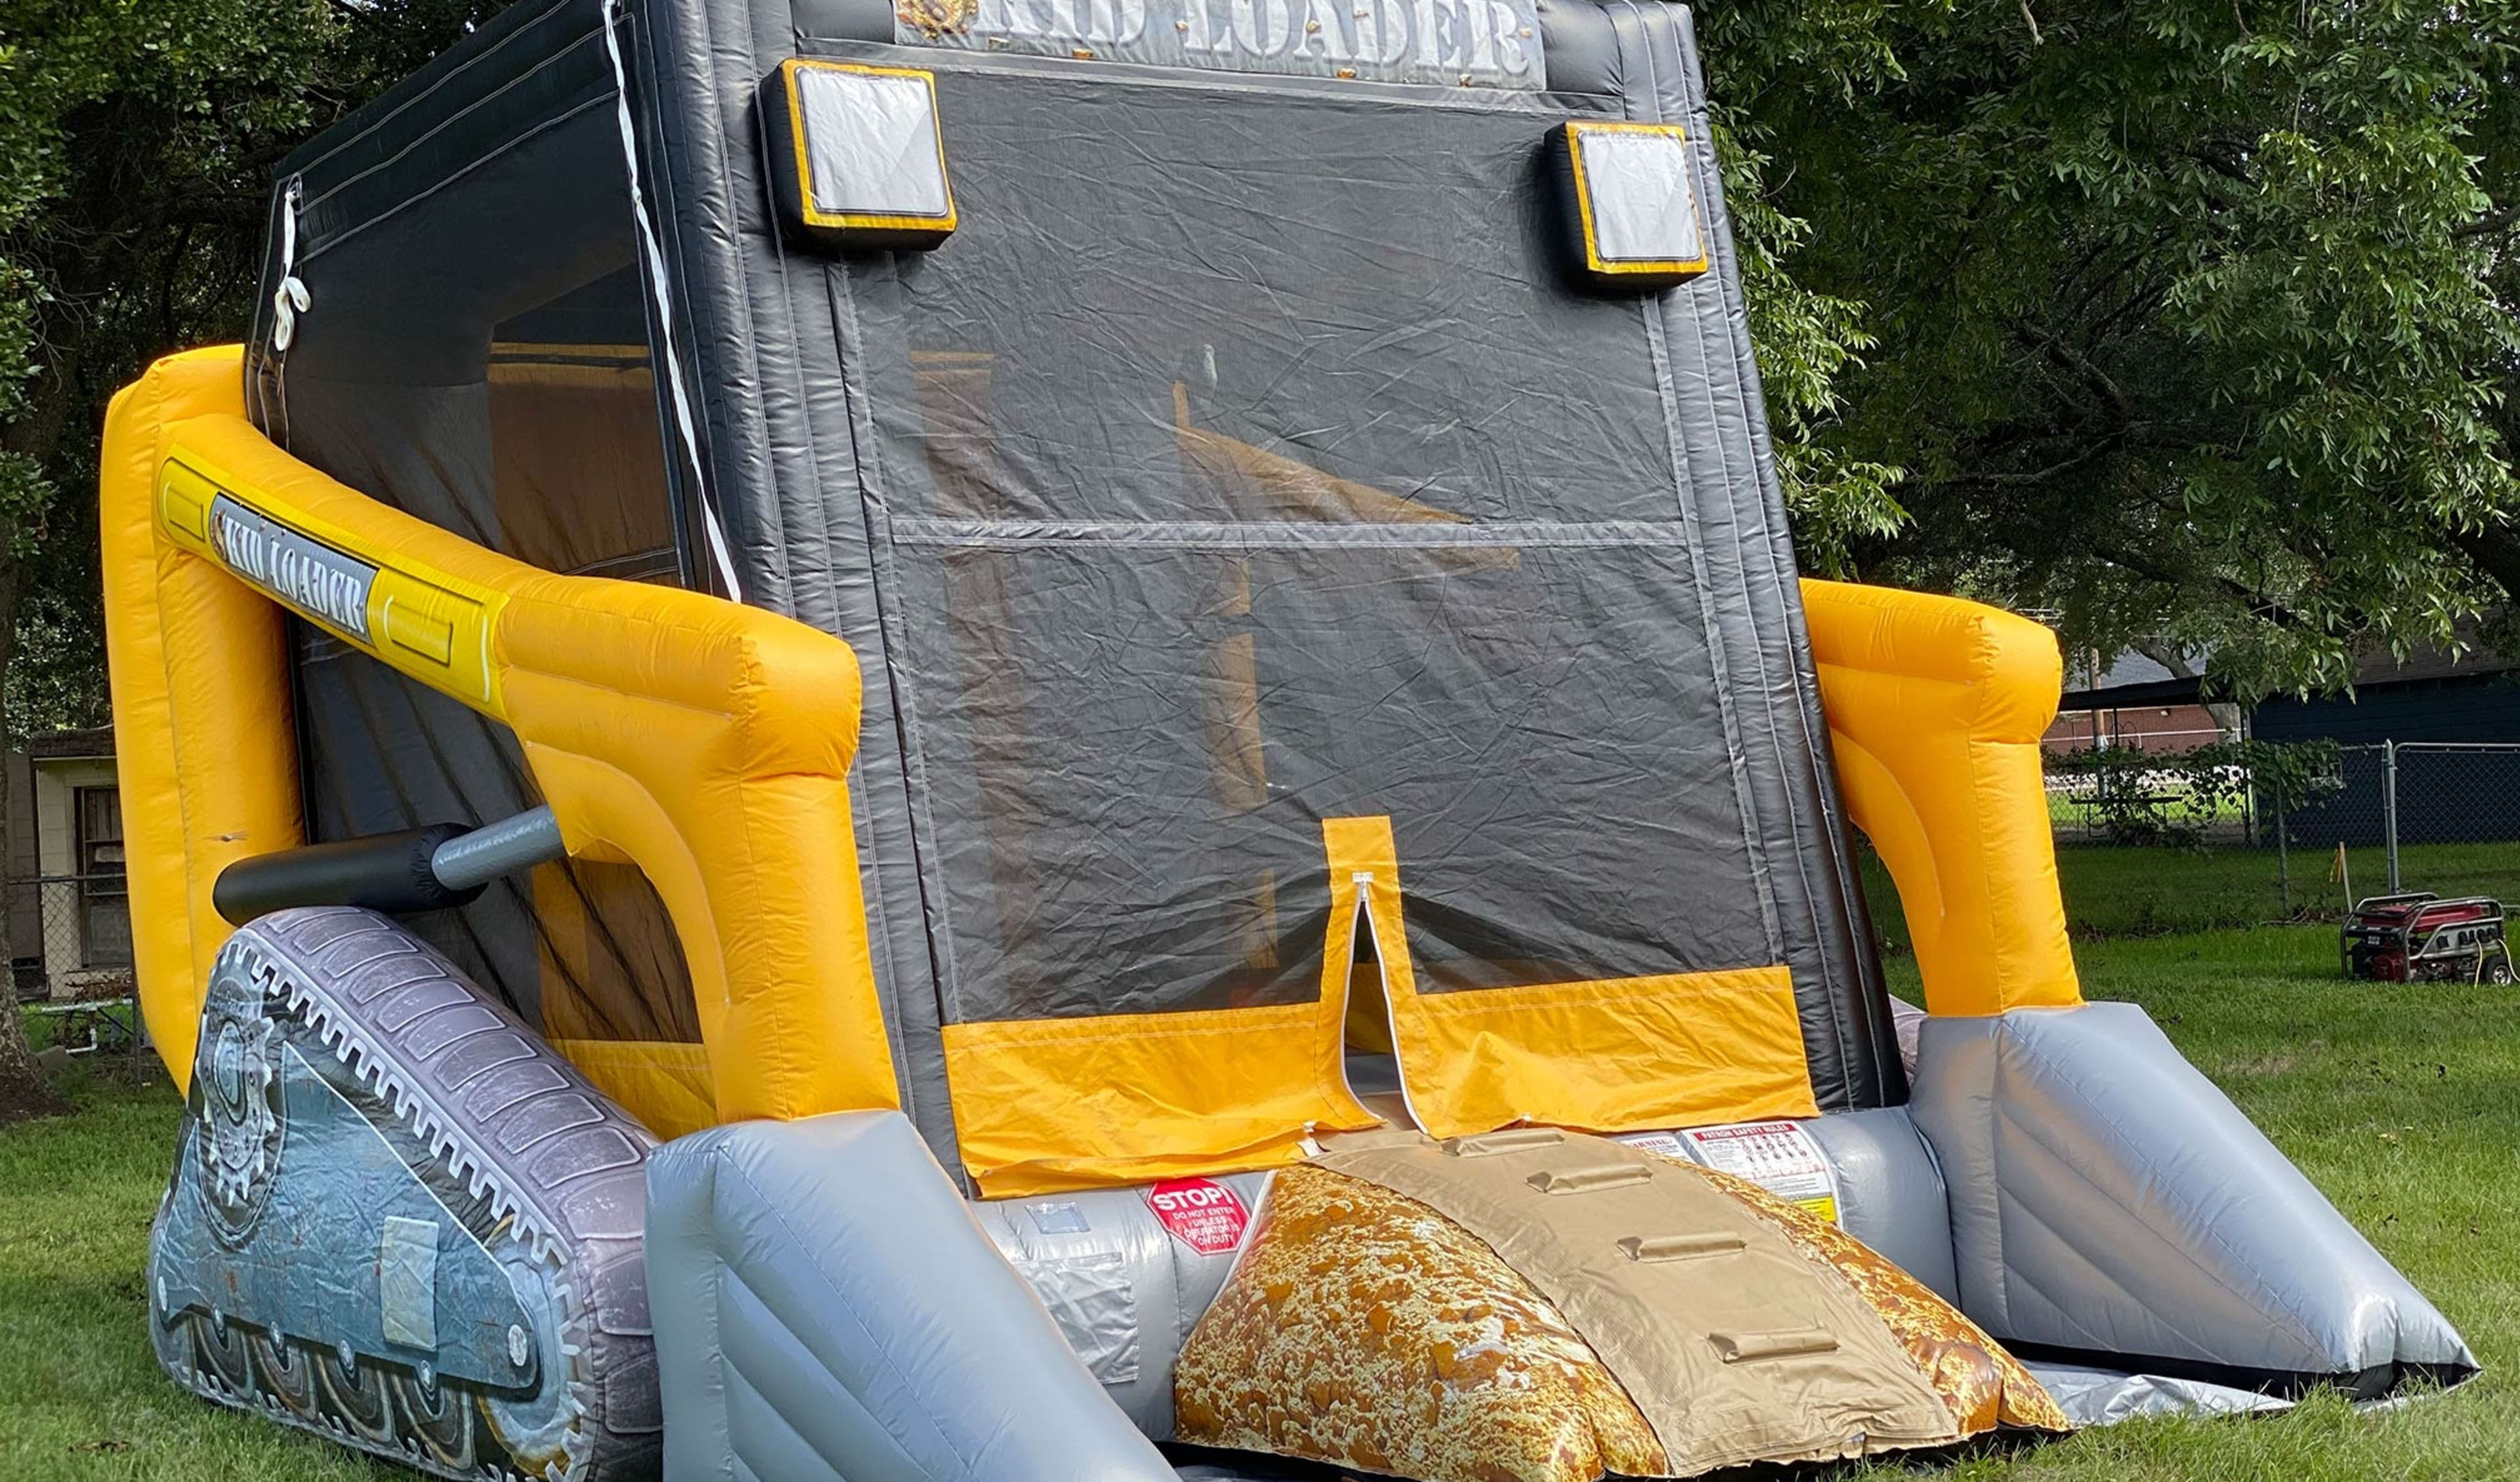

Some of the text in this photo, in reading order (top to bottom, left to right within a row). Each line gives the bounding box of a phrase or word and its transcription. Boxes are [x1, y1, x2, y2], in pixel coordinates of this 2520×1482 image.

[1183, 0, 1528, 74] LOADER
[270, 541, 365, 634] LOADER
[1701, 1129, 1735, 1139] PATRON
[1732, 1126, 1763, 1137] SAFETY
[1153, 1187, 1234, 1210] STOP!
[1172, 1206, 1234, 1220] DO NOT ENTER
[1192, 1216, 1228, 1226] UNLESS
[1197, 1233, 1234, 1246] ON DUTY
